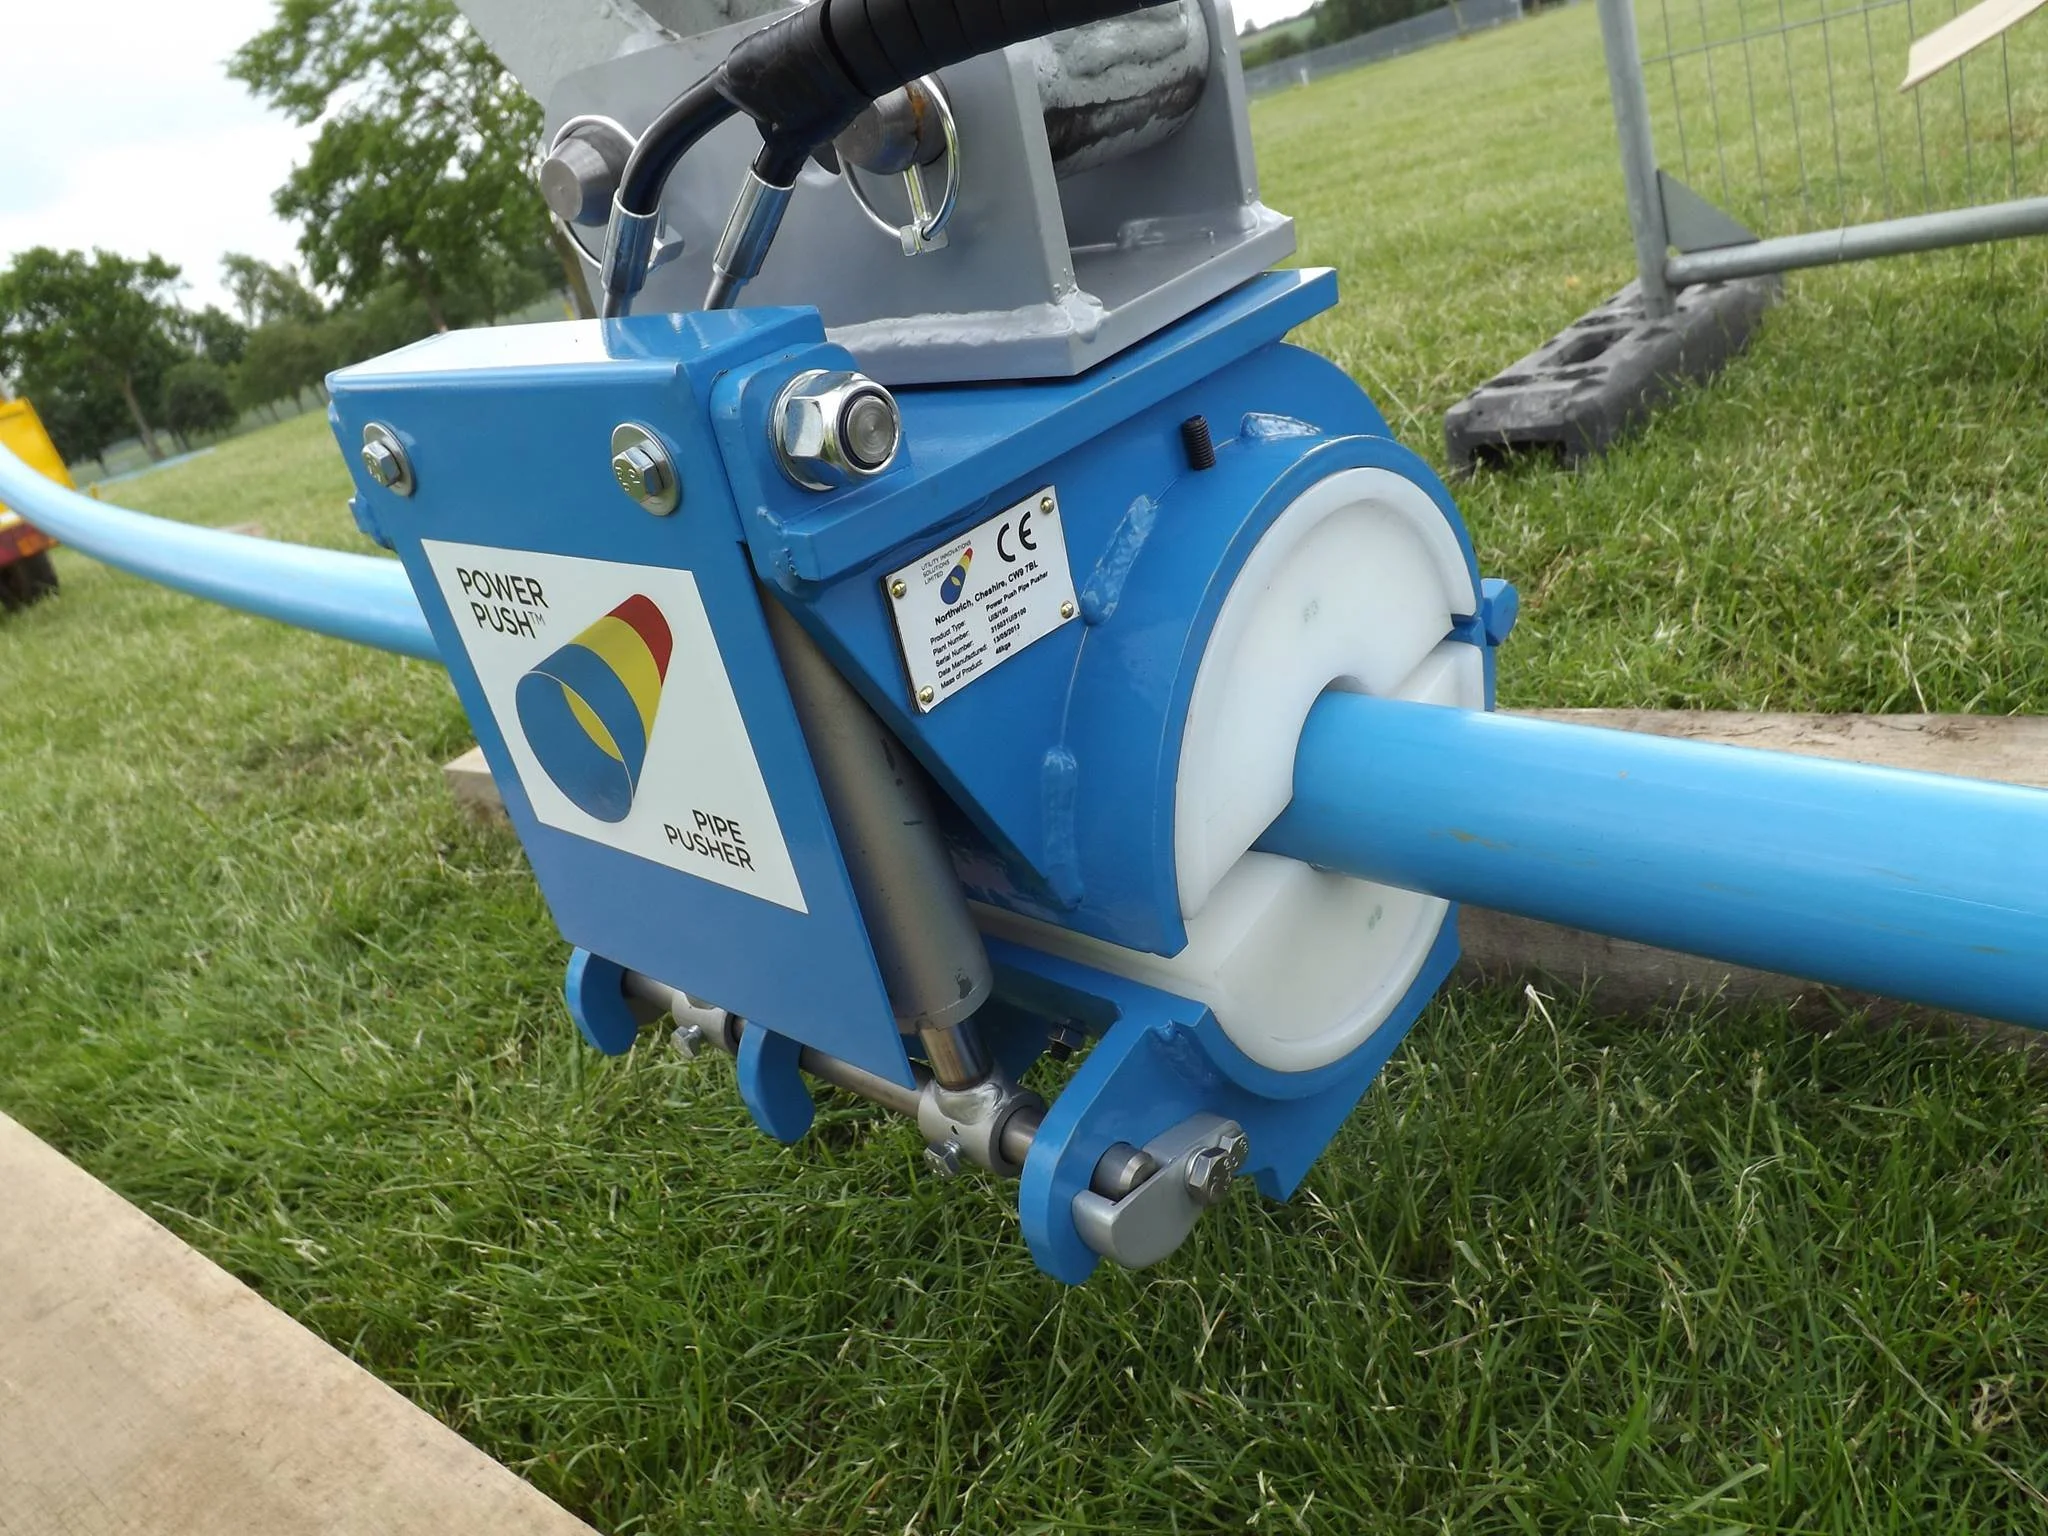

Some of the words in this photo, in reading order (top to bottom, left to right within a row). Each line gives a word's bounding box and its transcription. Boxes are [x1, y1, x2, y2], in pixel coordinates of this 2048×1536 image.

[921, 557, 939, 571] UTILITY
[923, 559, 950, 578] SOLUTIONS
[924, 571, 944, 585] LIMITED
[456, 567, 549, 609] POWER
[934, 599, 974, 626] Northwich,
[974, 580, 1008, 602] Cheshire,
[1008, 567, 1024, 583] CW9
[1024, 560, 1039, 573] 7BL
[929, 628, 951, 646] Product
[985, 598, 1003, 612] Power
[1003, 589, 1018, 602] Push
[1018, 582, 1030, 593] Pipe
[1030, 571, 1049, 586] Pusher
[932, 643, 947, 657] Plant
[935, 652, 951, 668] Serial
[692, 809, 746, 846] PIPE
[663, 823, 756, 873] PUSHER
